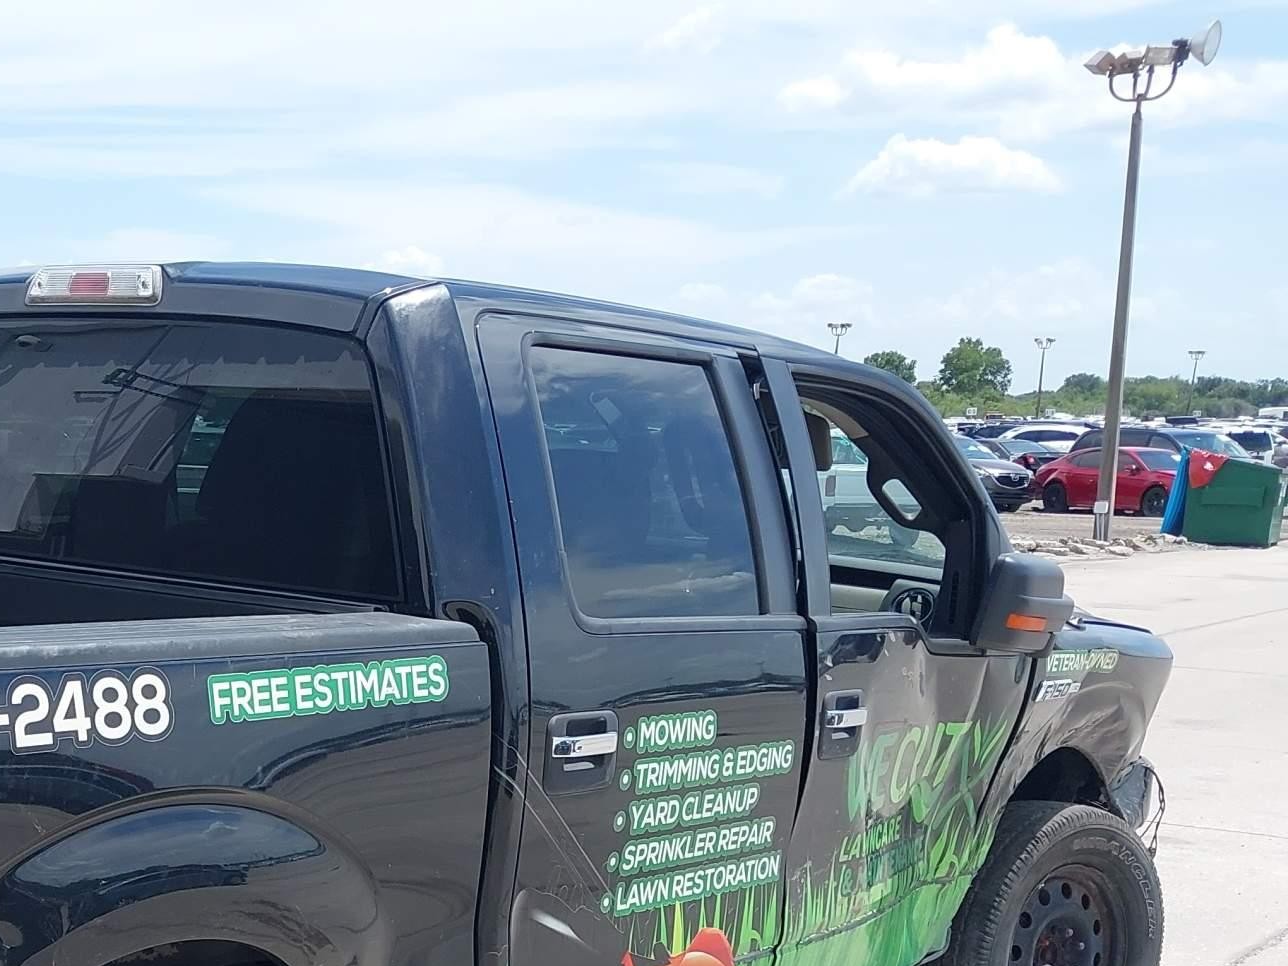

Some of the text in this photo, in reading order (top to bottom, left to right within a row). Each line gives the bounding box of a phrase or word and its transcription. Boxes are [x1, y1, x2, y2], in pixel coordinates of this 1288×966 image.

[212, 662, 446, 718] FREE ESTIMATES
[639, 715, 715, 748] MOWING
[637, 744, 793, 789] TRIMMING & EDGING
[631, 787, 759, 830] YARD CLEANUP
[622, 820, 774, 871] SPRINKLER REPAIR
[616, 854, 781, 911] LAWN RESTORATION
